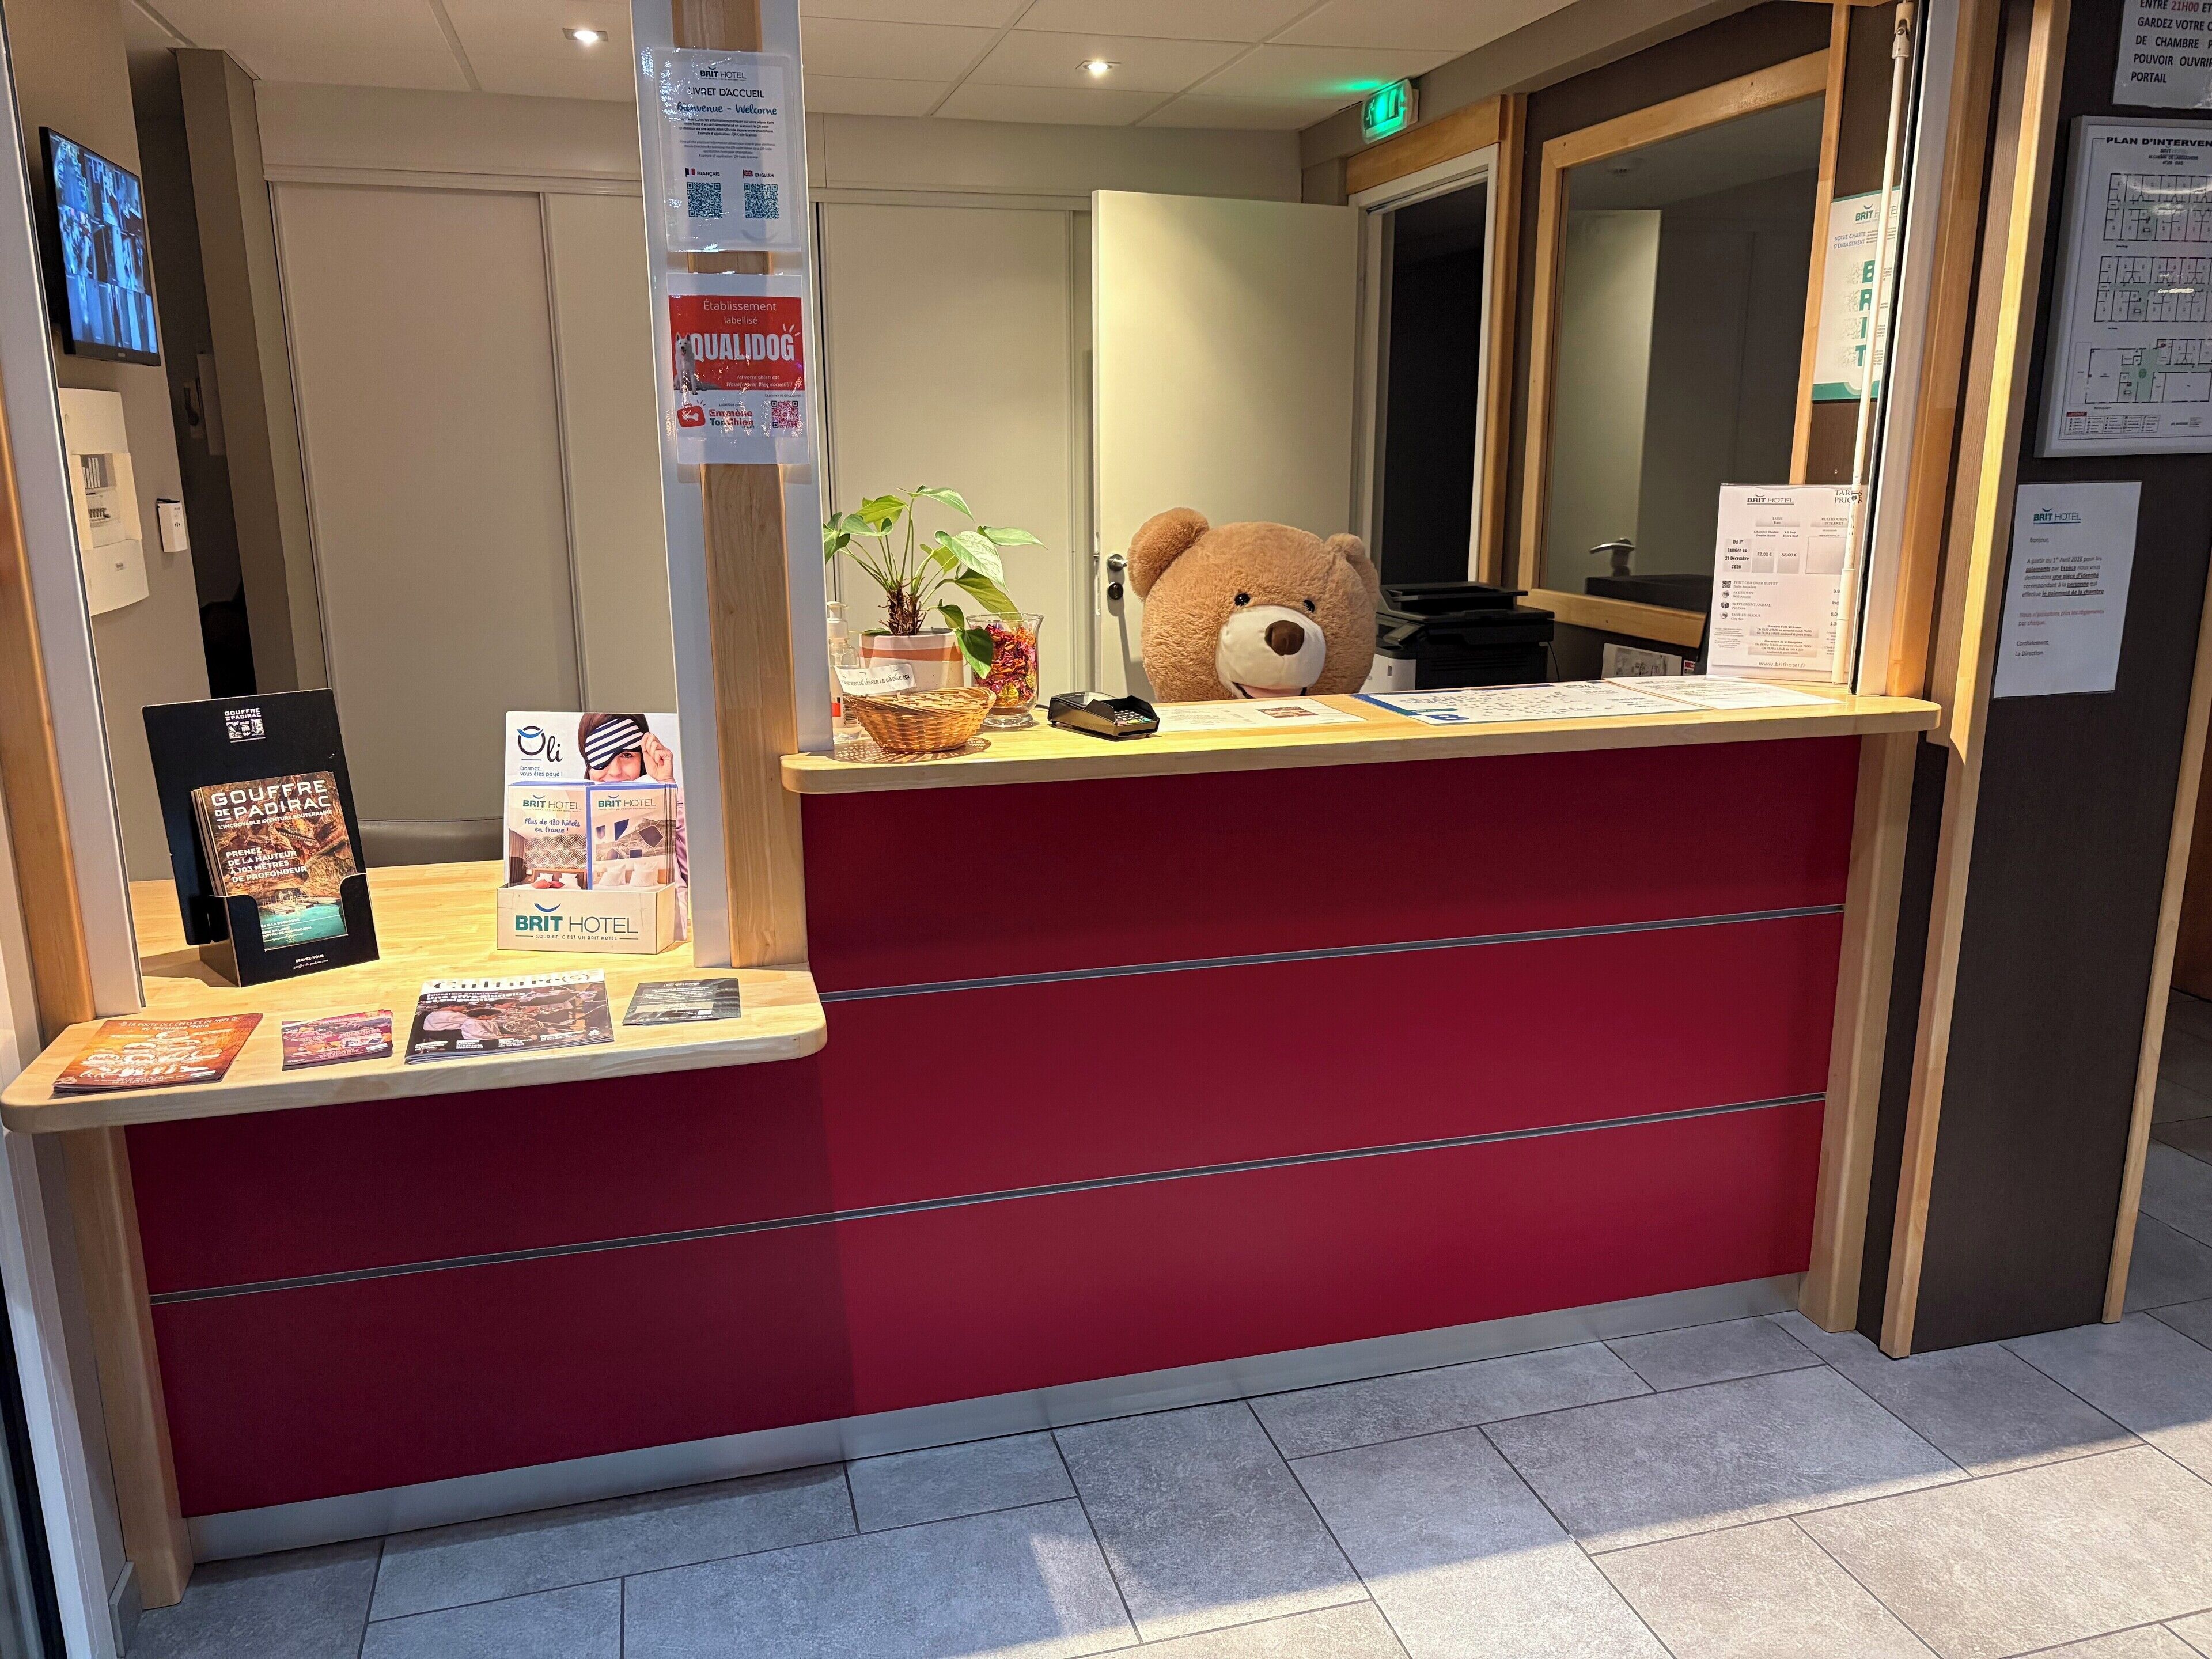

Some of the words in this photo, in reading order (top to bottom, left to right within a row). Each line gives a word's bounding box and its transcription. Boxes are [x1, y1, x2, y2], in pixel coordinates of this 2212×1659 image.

[2140, 0, 2167, 10] ENTRE
[2171, 1, 2199, 12] 21H00
[2138, 17, 2173, 28] GARDEZ
[2176, 20, 2205, 31] VOTRE
[2135, 35, 2147, 45] DE
[2156, 36, 2199, 48] CHAMBRE
[2134, 53, 2173, 65] POUVOIR
[2131, 71, 2167, 83] PORTAIL
[719, 88, 765, 98] D'ACCUEIL
[677, 101, 723, 113] Bienvenue
[736, 104, 777, 115] Welcome
[2106, 137, 2138, 145] PLAN
[1855, 210, 1873, 221] BRIT
[703, 298, 777, 311] Établissement
[724, 316, 758, 324] labellisé
[691, 332, 795, 362] QUALIDOG
[2055, 512, 2081, 521] HOTEL
[224, 707, 261, 716] GOUFFRE
[517, 725, 563, 762] Oli
[211, 779, 328, 806] GOUFFRE
[215, 808, 230, 817] DE
[233, 795, 331, 819] PADIRAC
[523, 800, 546, 808] BRIT
[548, 801, 582, 810] HOTEL
[598, 800, 622, 808] BRIT
[624, 798, 656, 807] HOTEL
[218, 819, 261, 830] L'INCROYABLE
[261, 815, 292, 824] AVENTURE
[293, 809, 332, 820] SOUTERRAINE
[562, 819, 581, 827] hôtels
[226, 847, 262, 858] PRENEZ
[255, 850, 297, 862] HAUTEUR
[238, 866, 253, 874] 103
[246, 866, 308, 881] PROFONDEUR
[515, 915, 563, 931] BRIT
[569, 916, 639, 934] HOTEL
[296, 954, 324, 963] SERVEZ-VOUS
